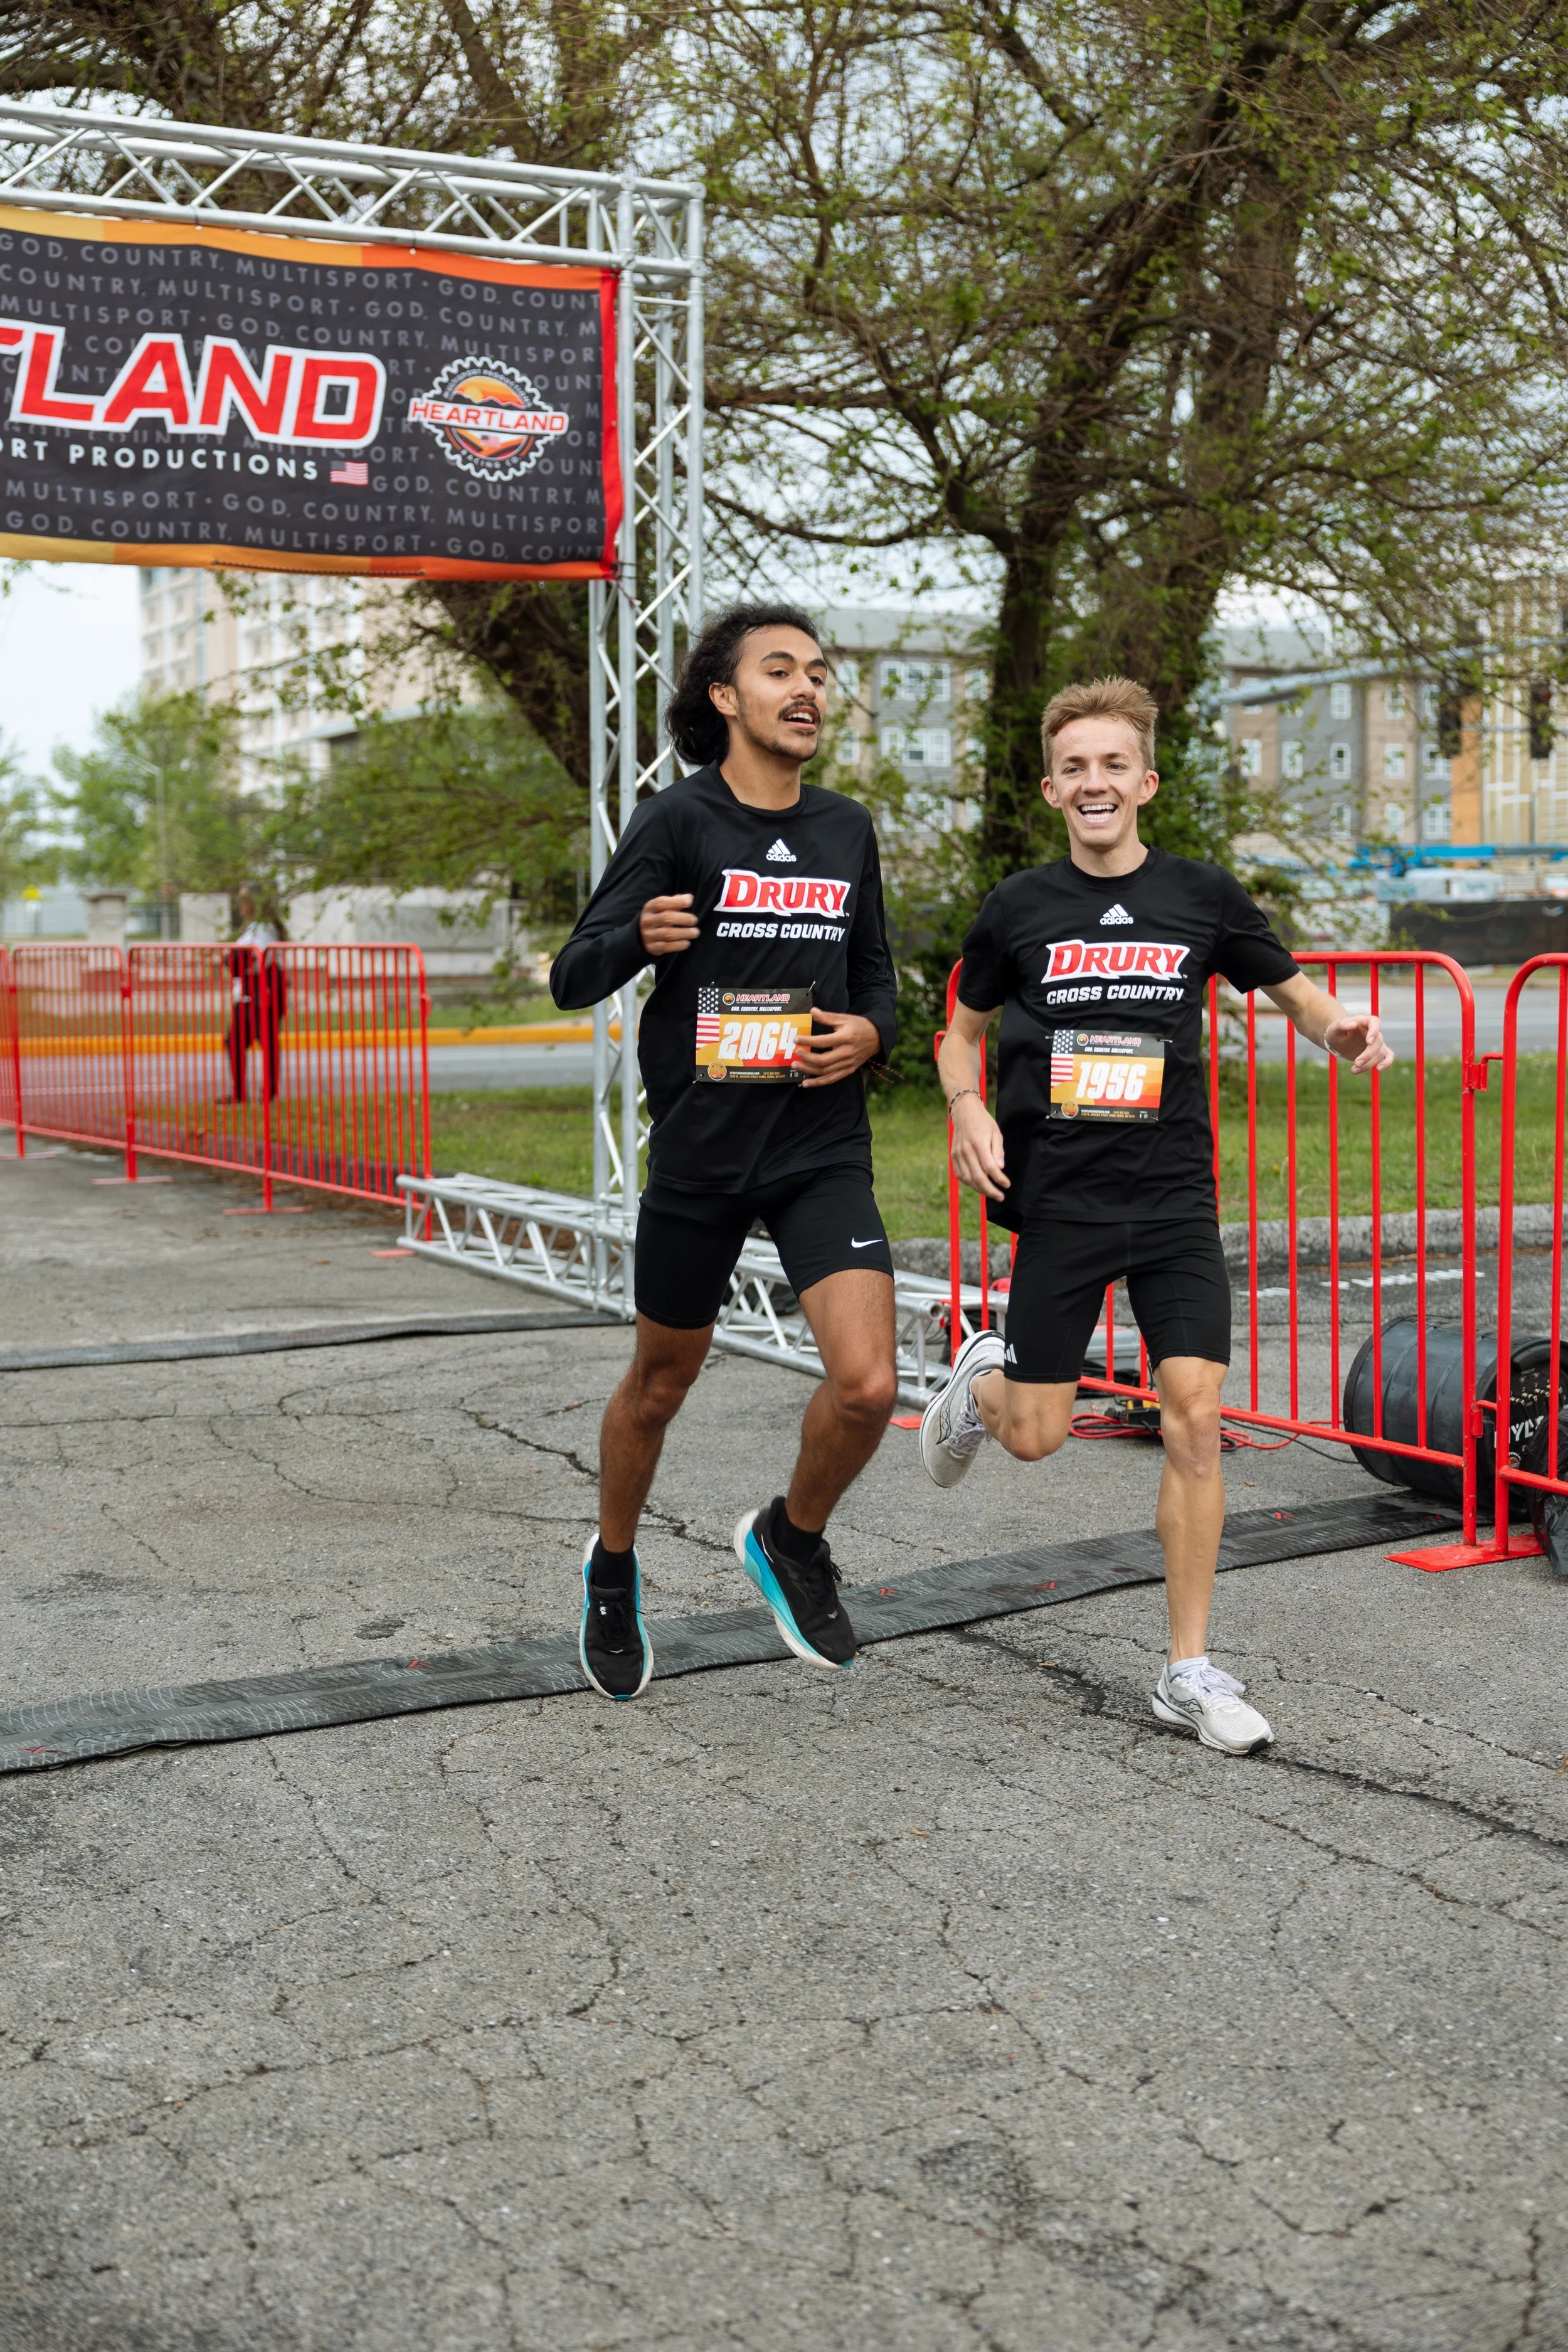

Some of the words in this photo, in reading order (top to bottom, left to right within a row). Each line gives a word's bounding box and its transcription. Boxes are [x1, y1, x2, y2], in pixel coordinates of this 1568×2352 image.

[236, 258, 413, 289] MULTISPORT
[158, 279, 339, 315] MULTISPORT
[1, 294, 190, 326] MULTISPORT
[440, 334, 602, 364] MULTISPOR
[411, 401, 565, 432] HEARTLAND
[0, 435, 48, 461] RT
[68, 443, 318, 480] PRODUCTIONS
[6, 479, 196, 509] MULTISPORT
[446, 507, 607, 534] MULTISPOR
[244, 526, 421, 552] MULTISPORT
[766, 852, 797, 862] adidas
[721, 872, 847, 914] DRURY
[716, 923, 778, 938] CROSS
[780, 924, 845, 942] COUNTRY
[1099, 915, 1134, 925] adidas
[1048, 943, 1185, 978] DRURY
[1046, 986, 1103, 1005] CROSS
[1107, 985, 1184, 1001] COUNTRY
[718, 1022, 798, 1061] 2064
[1089, 1035, 1142, 1045] HEARTLAND
[1076, 1061, 1147, 1101] 1956
